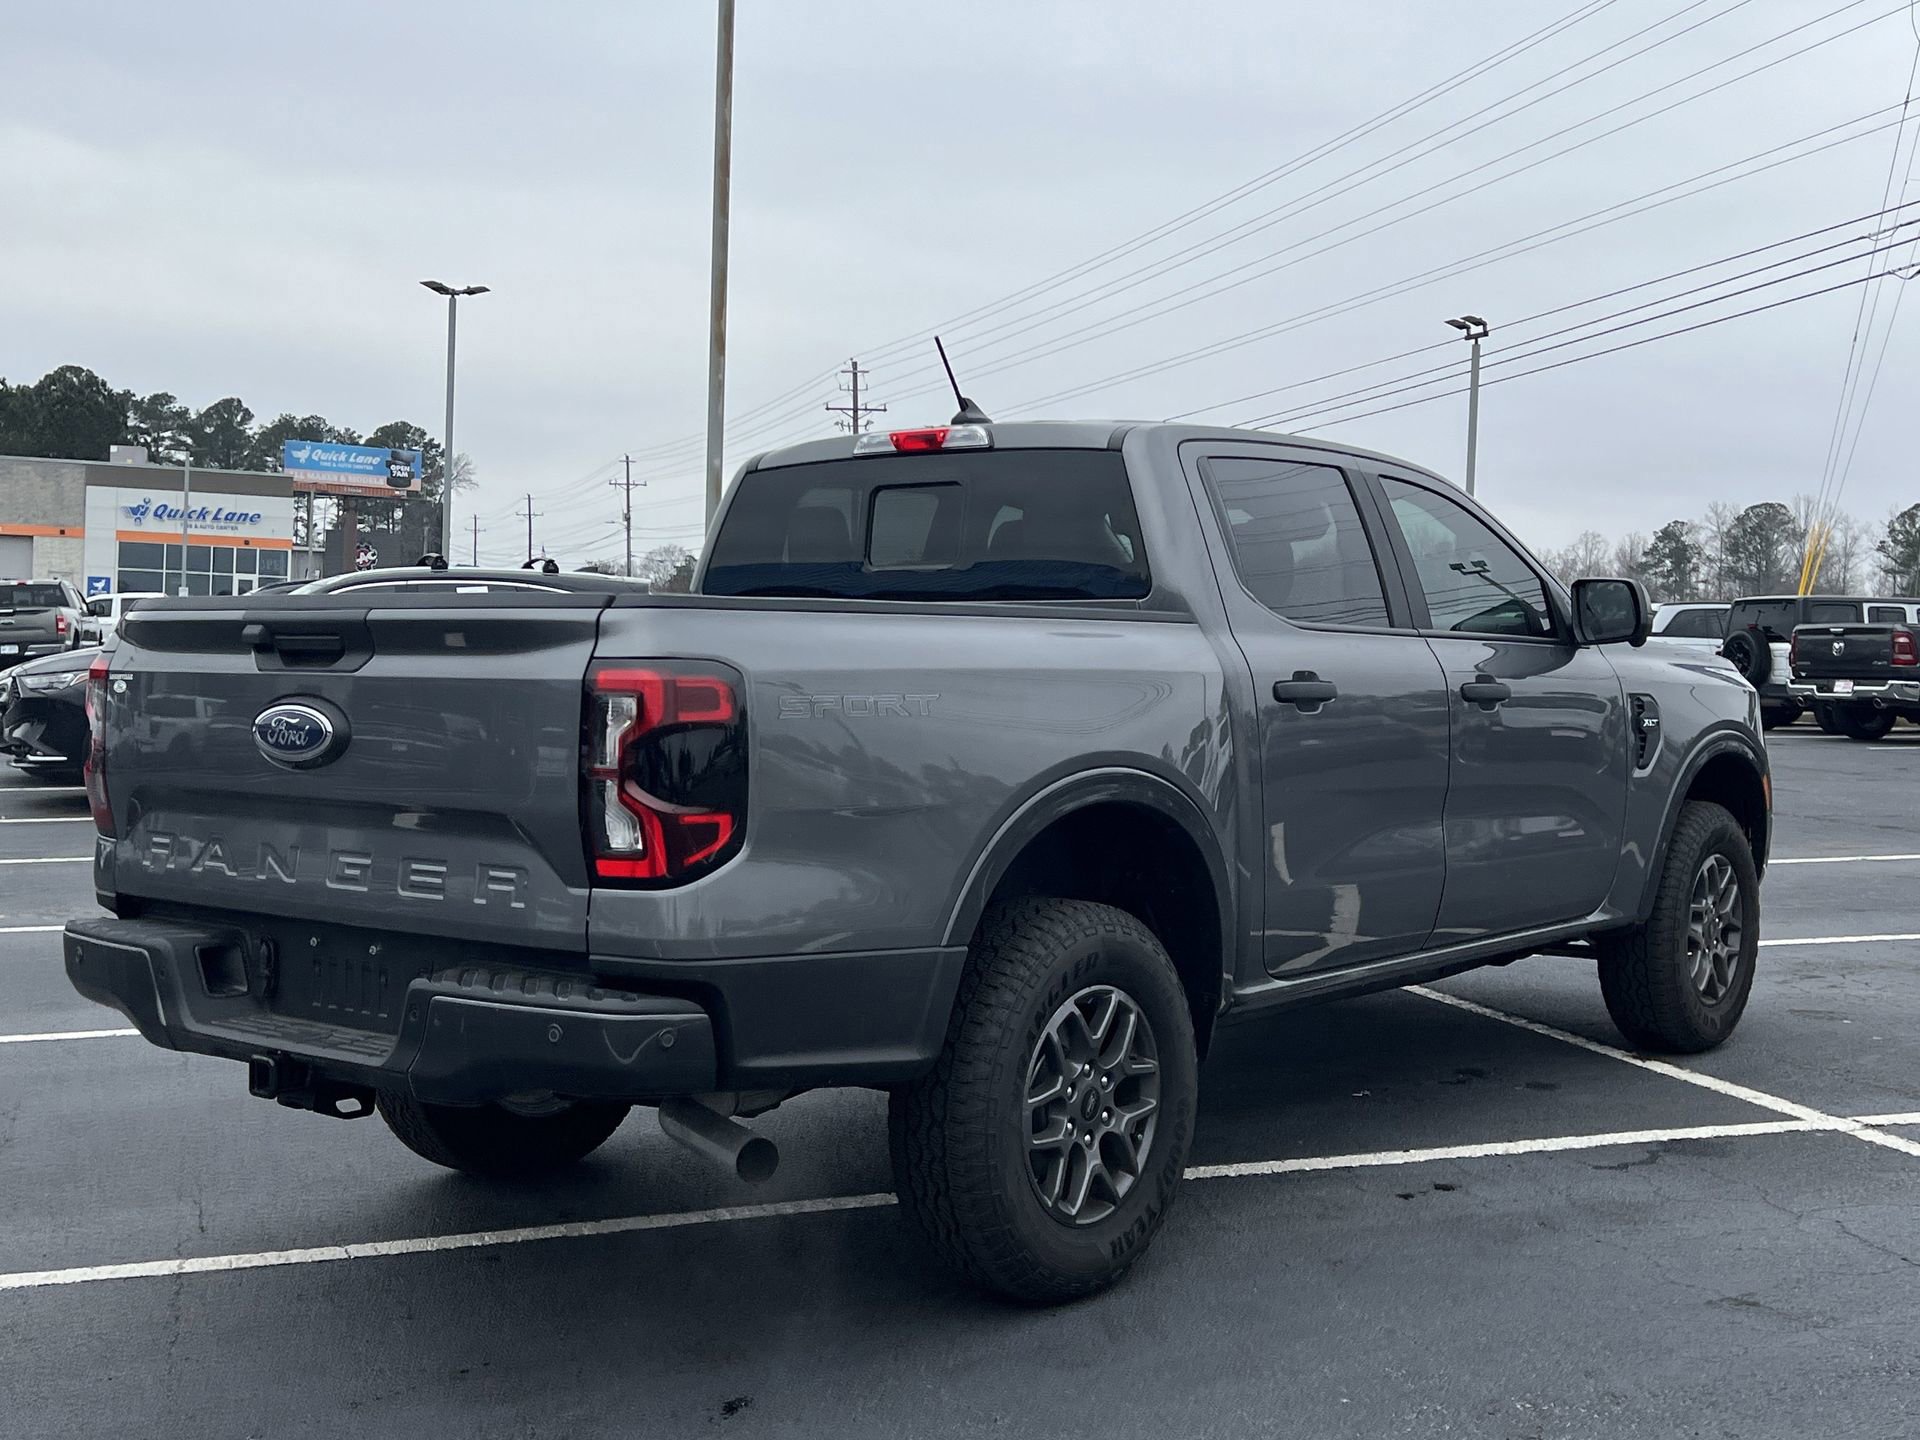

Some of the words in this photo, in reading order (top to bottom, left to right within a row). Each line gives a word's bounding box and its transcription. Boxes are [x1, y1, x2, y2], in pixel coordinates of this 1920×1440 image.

[311, 448, 346, 462] Quick
[348, 452, 381, 465] Lane
[390, 464, 410, 472] OPEN
[392, 470, 409, 478] 7AM
[153, 503, 210, 521] Quick
[211, 507, 262, 523] Lane
[778, 693, 942, 720] SPORT
[266, 716, 310, 746] Ford
[1643, 718, 1659, 727] XLT
[141, 828, 530, 909] RANGER
